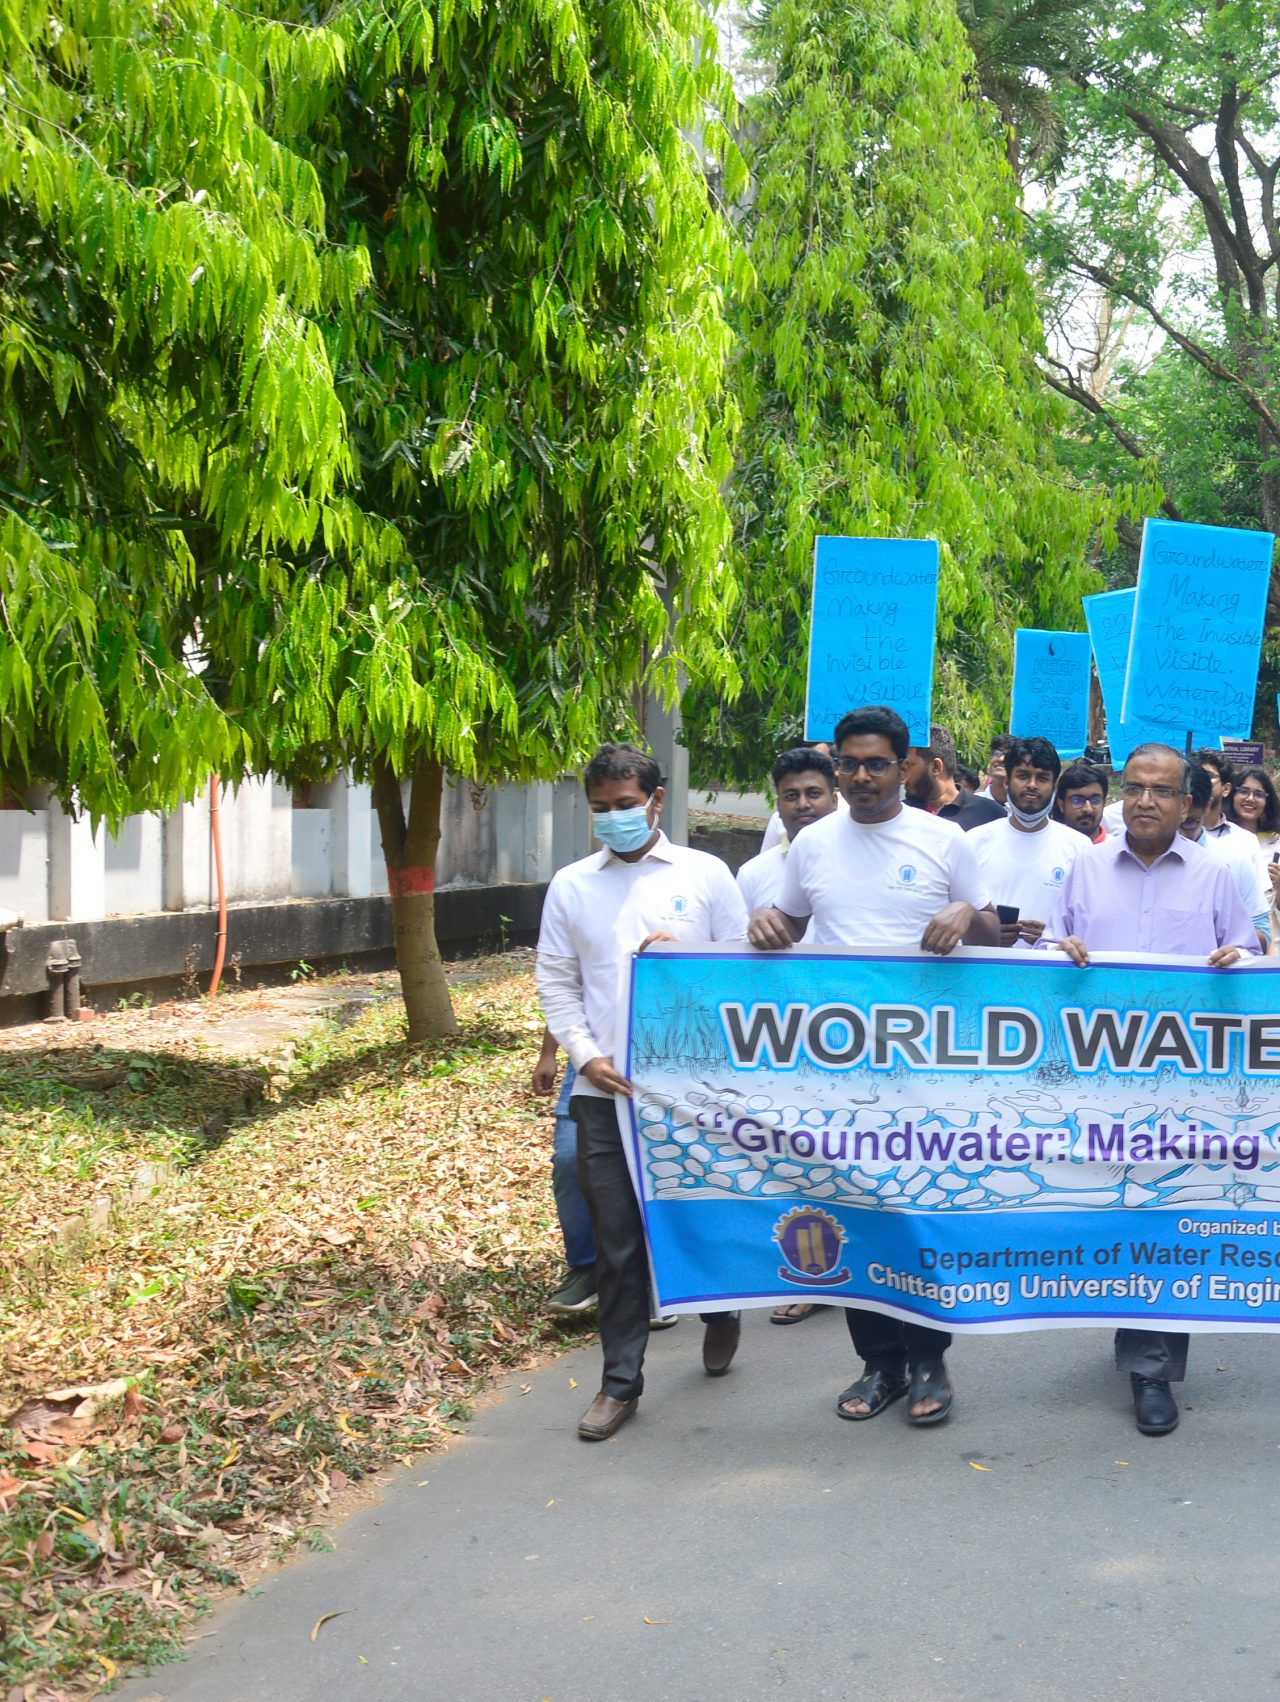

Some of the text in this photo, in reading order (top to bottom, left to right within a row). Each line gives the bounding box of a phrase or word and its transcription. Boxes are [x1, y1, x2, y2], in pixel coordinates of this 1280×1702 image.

[1163, 573, 1241, 625] Making
[860, 623, 912, 652] the
[1153, 616, 1186, 641] the
[1033, 658, 1080, 676] KEEP
[1029, 677, 1084, 696] CALM
[1038, 696, 1073, 710] AND
[1150, 702, 1186, 724] 22
[1193, 705, 1253, 732] MARCH
[1026, 711, 1080, 730] SAVE
[722, 1005, 1040, 1067] WORLD
[1088, 1123, 1261, 1171] Making
[1177, 1217, 1268, 1238] Organized
[918, 1242, 1084, 1275] Department
[1093, 1242, 1121, 1267] of
[1129, 1242, 1210, 1268] Water
[866, 1261, 1012, 1309] Chittagong
[1019, 1272, 1164, 1305] University
[1171, 1274, 1202, 1301] of
